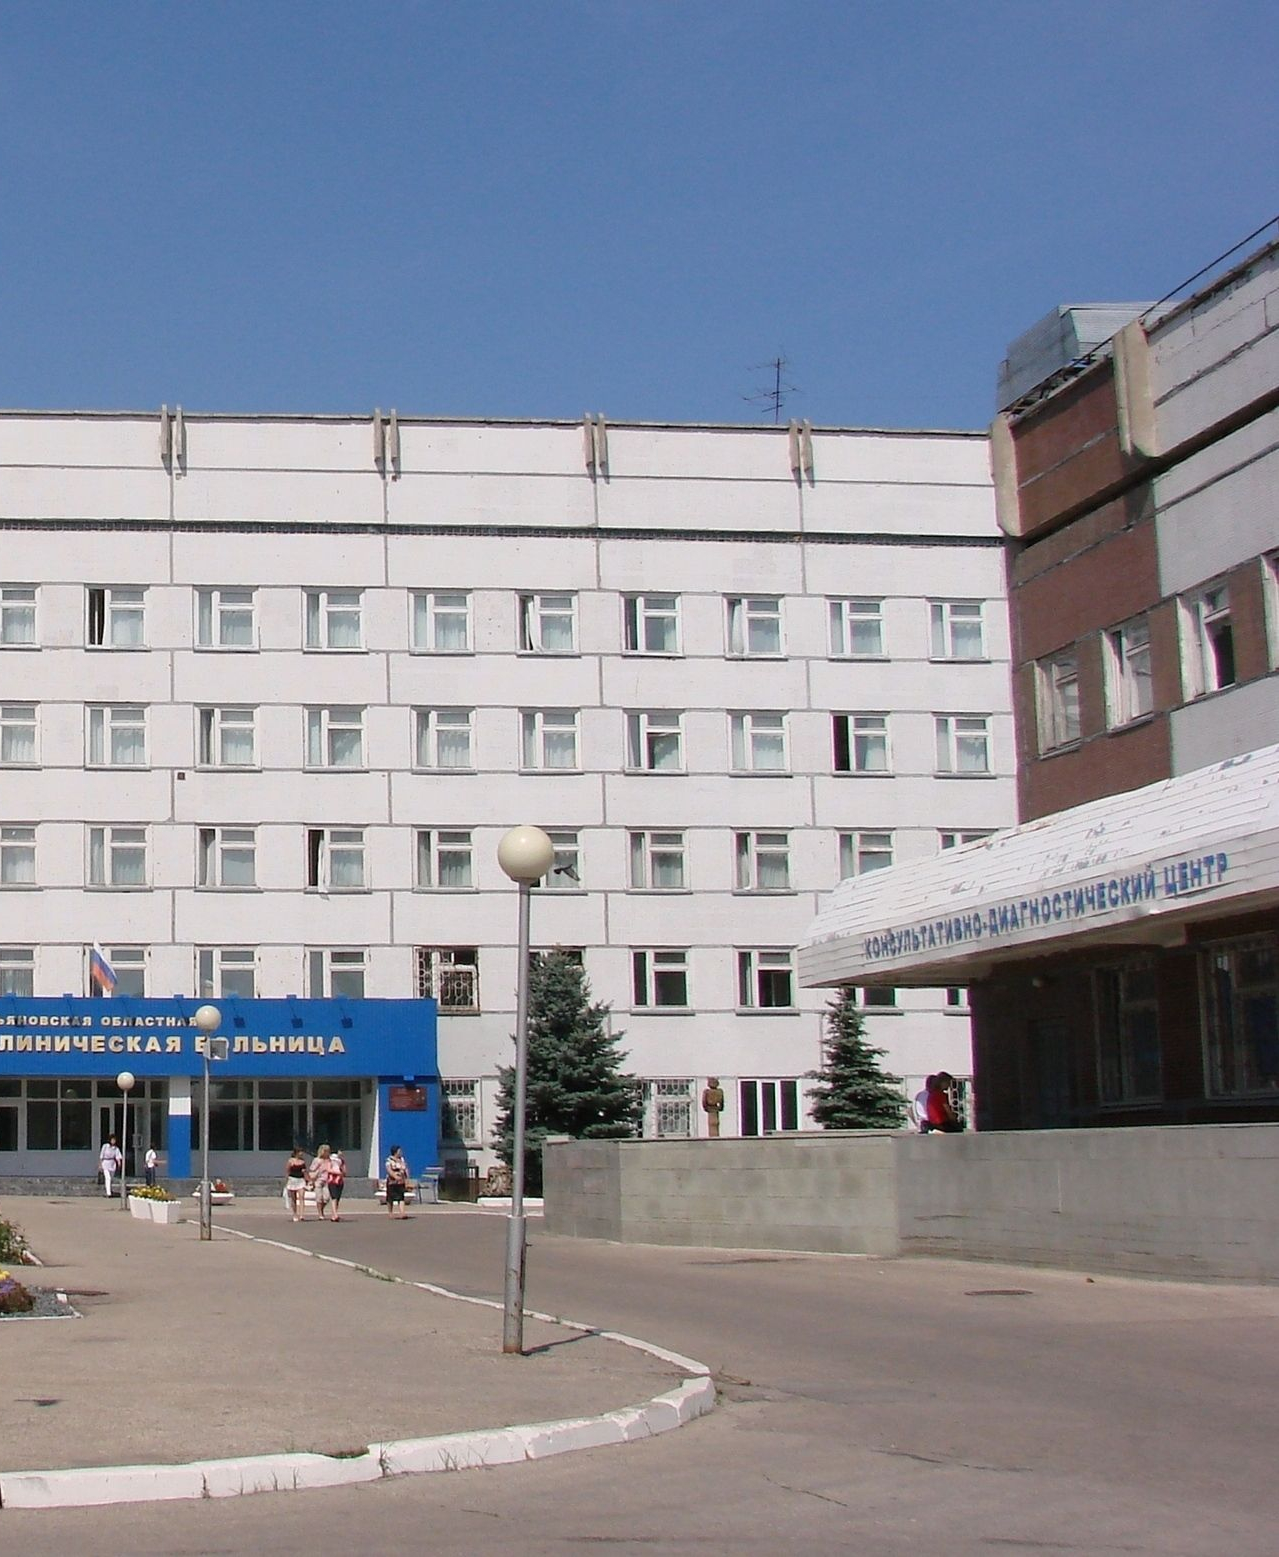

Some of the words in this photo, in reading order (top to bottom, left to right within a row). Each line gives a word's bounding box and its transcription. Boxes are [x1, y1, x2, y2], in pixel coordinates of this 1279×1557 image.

[864, 863, 1156, 960] КОНСУЛЬТАТИВНО-ДИАГНОСТИЧЕСКИЙ
[1164, 852, 1228, 895] ЦЕНТР
[101, 1016, 197, 1027] ОБЛАСТНАЯ
